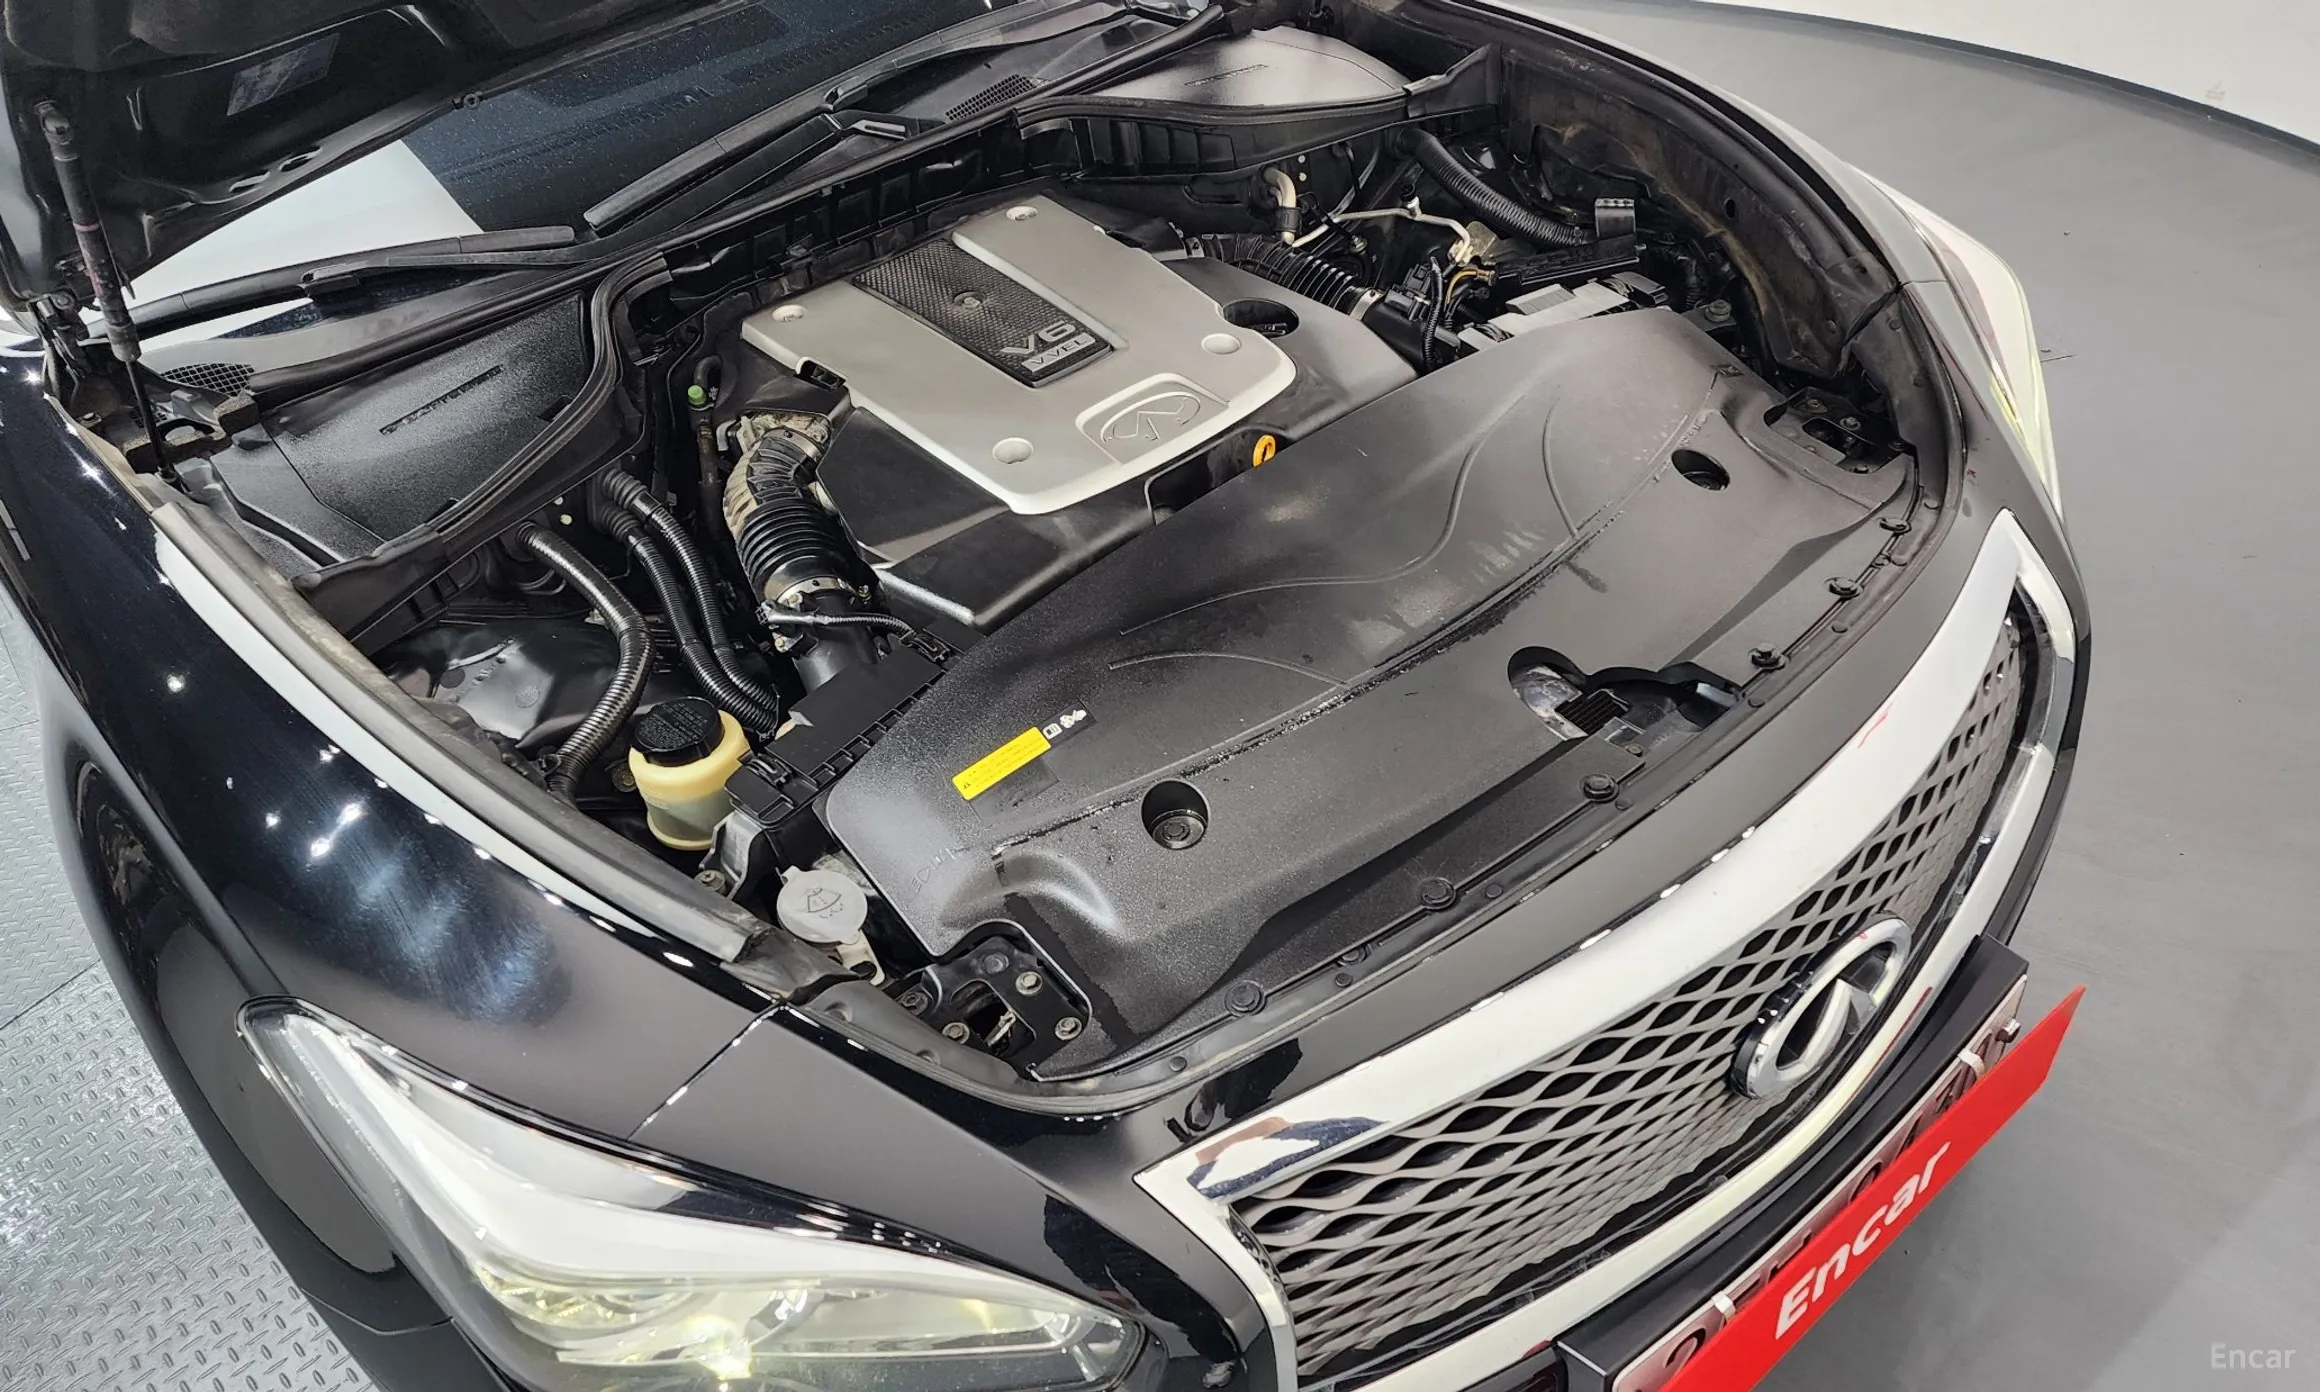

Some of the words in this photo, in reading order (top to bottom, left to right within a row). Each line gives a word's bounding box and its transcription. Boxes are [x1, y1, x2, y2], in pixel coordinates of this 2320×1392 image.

[1000, 320, 1076, 356] V6
[1030, 332, 1090, 366] VVEL
[1774, 1141, 1950, 1340] Encar
